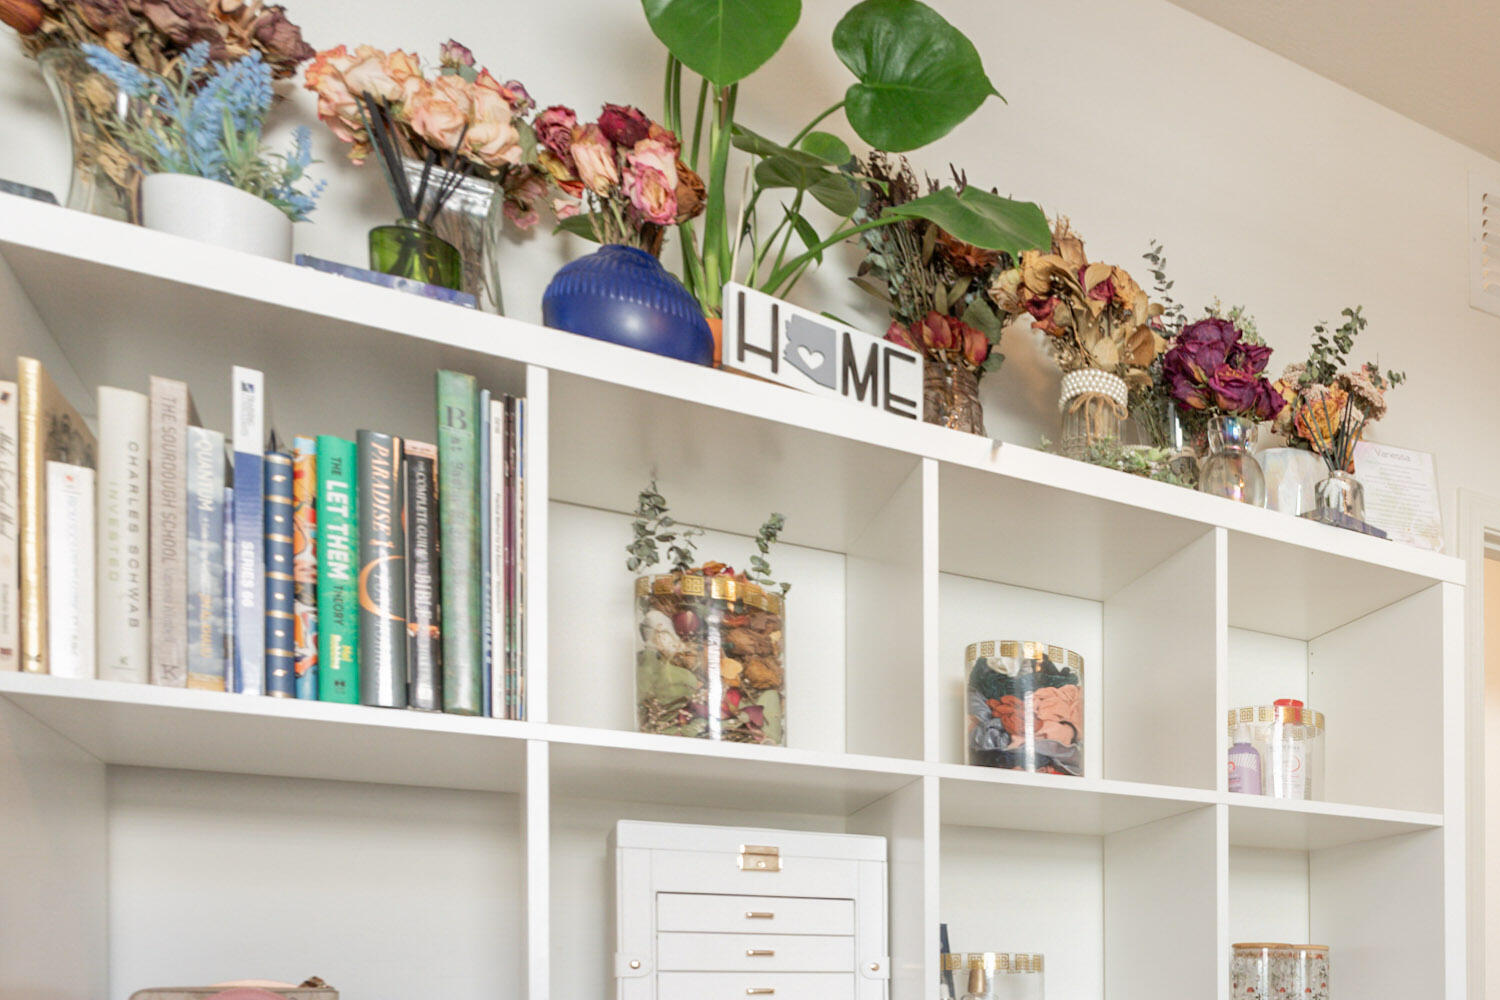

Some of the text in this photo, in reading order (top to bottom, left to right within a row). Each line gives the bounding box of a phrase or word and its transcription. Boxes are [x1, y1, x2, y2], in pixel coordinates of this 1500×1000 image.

[161, 397, 178, 564] THE SOURDOUGH SCHOOL
[195, 439, 214, 511] QUANTUM
[371, 441, 394, 537] PARADISE
[415, 470, 430, 524] COMPLETE
[108, 480, 119, 583] INVESTED
[128, 440, 140, 630] CHARLES SCHWAB
[241, 540, 255, 588] SERIES
[326, 457, 350, 626] THE LET THEM THEORY
